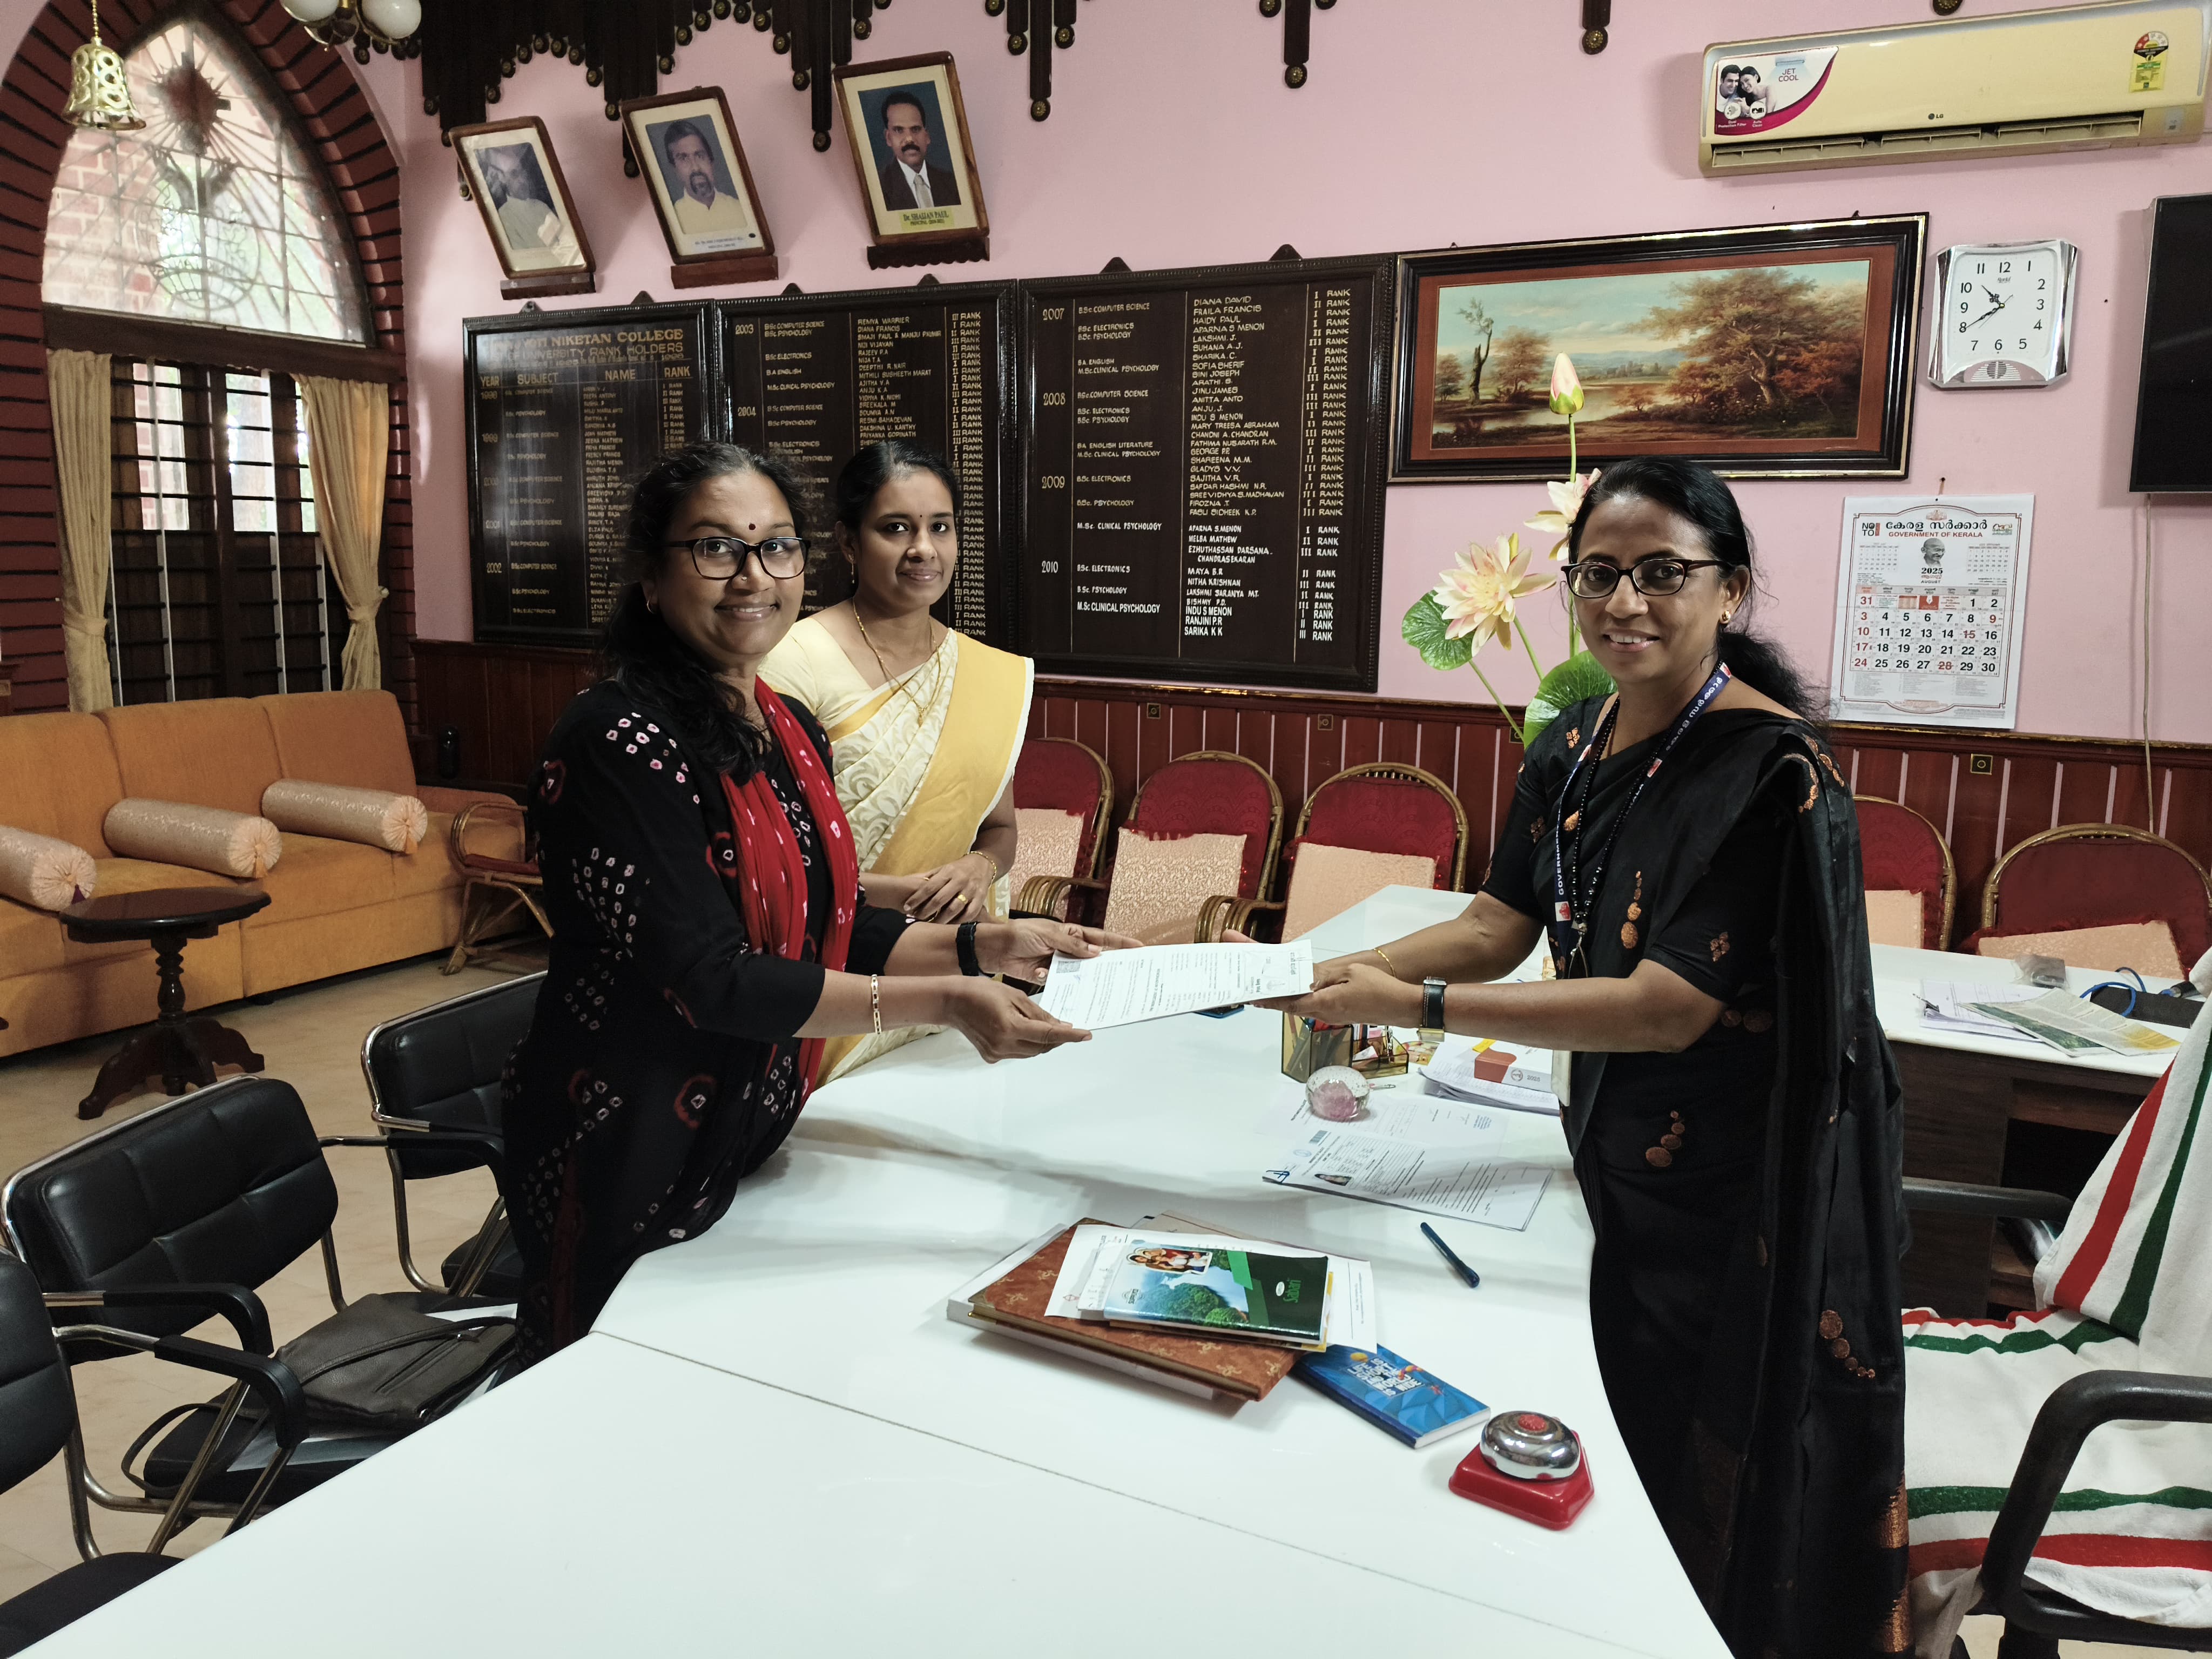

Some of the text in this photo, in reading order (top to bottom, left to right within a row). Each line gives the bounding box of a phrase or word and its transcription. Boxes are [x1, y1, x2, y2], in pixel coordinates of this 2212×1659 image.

[1977, 263, 1984, 274] 11
[1999, 262, 2010, 273] 12
[2028, 261, 2031, 271] 1
[1961, 282, 1972, 293] 10
[2038, 279, 2045, 289] 2
[1314, 288, 1350, 299] I RANK
[1194, 298, 1222, 306] DIANA
[1326, 299, 1350, 307] RANK
[1960, 302, 1968, 313] 9
[2036, 299, 2044, 310] 3
[960, 312, 981, 320] RANK
[1042, 308, 1064, 320] 2007
[1193, 305, 1262, 316] FRAILA FRANCIS
[1220, 315, 1240, 323] PAUL
[735, 323, 754, 335] 2003
[1237, 323, 1264, 331] MENON
[1959, 322, 1966, 333] 8
[2034, 320, 2042, 330] 4
[551, 329, 683, 346] NIKETAN COLLEGE
[590, 347, 621, 356] RANK
[627, 342, 683, 354] HOLDERS
[1971, 340, 1978, 350] 7
[1995, 339, 2002, 350] 6
[2019, 339, 2027, 349] 5
[481, 366, 690, 387] YEAR SUBJECT NAME RANK
[1043, 393, 1065, 406] 2008
[738, 406, 756, 416] 2004
[1042, 475, 1065, 489] 2009
[1886, 520, 1987, 531] കേരള സർക്കാർ
[1303, 537, 1339, 546] II RANK
[1189, 545, 1234, 554] EZHUTHASSAN
[1301, 548, 1338, 556] III RANK
[1198, 555, 1255, 563] CHANDRASEKARAN
[486, 563, 502, 574] 2002
[1041, 560, 1058, 574] 2010
[1188, 578, 1241, 586] NITHA KRISHNAN
[1300, 581, 1309, 589] III
[1860, 596, 1997, 607] 31 1 2
[1077, 602, 1161, 613] M.Sc CLINICAL PSYCHOLOGY
[1185, 606, 1232, 616] INDU S MENON
[1302, 609, 1333, 619] I RANK
[1903, 612, 1910, 621] 5
[1946, 613, 1953, 622] 7
[1990, 615, 1996, 623] 9
[1185, 616, 1223, 625] RANJINI P.R
[1300, 619, 1333, 630] II RANK
[1184, 626, 1223, 636] SARIKA K K
[1312, 631, 1332, 641] RANK
[1858, 627, 1997, 639] 10 11 12 13 14 15 16
[1856, 643, 1996, 656] 17 18 19 20 21 22 23
[1854, 658, 1995, 671] 24 25 26 27 28 29 30
[1347, 1362, 1372, 1374] LIFE
[1357, 1363, 1392, 1380] SHORT
[1395, 1379, 1421, 1391] WIDE
